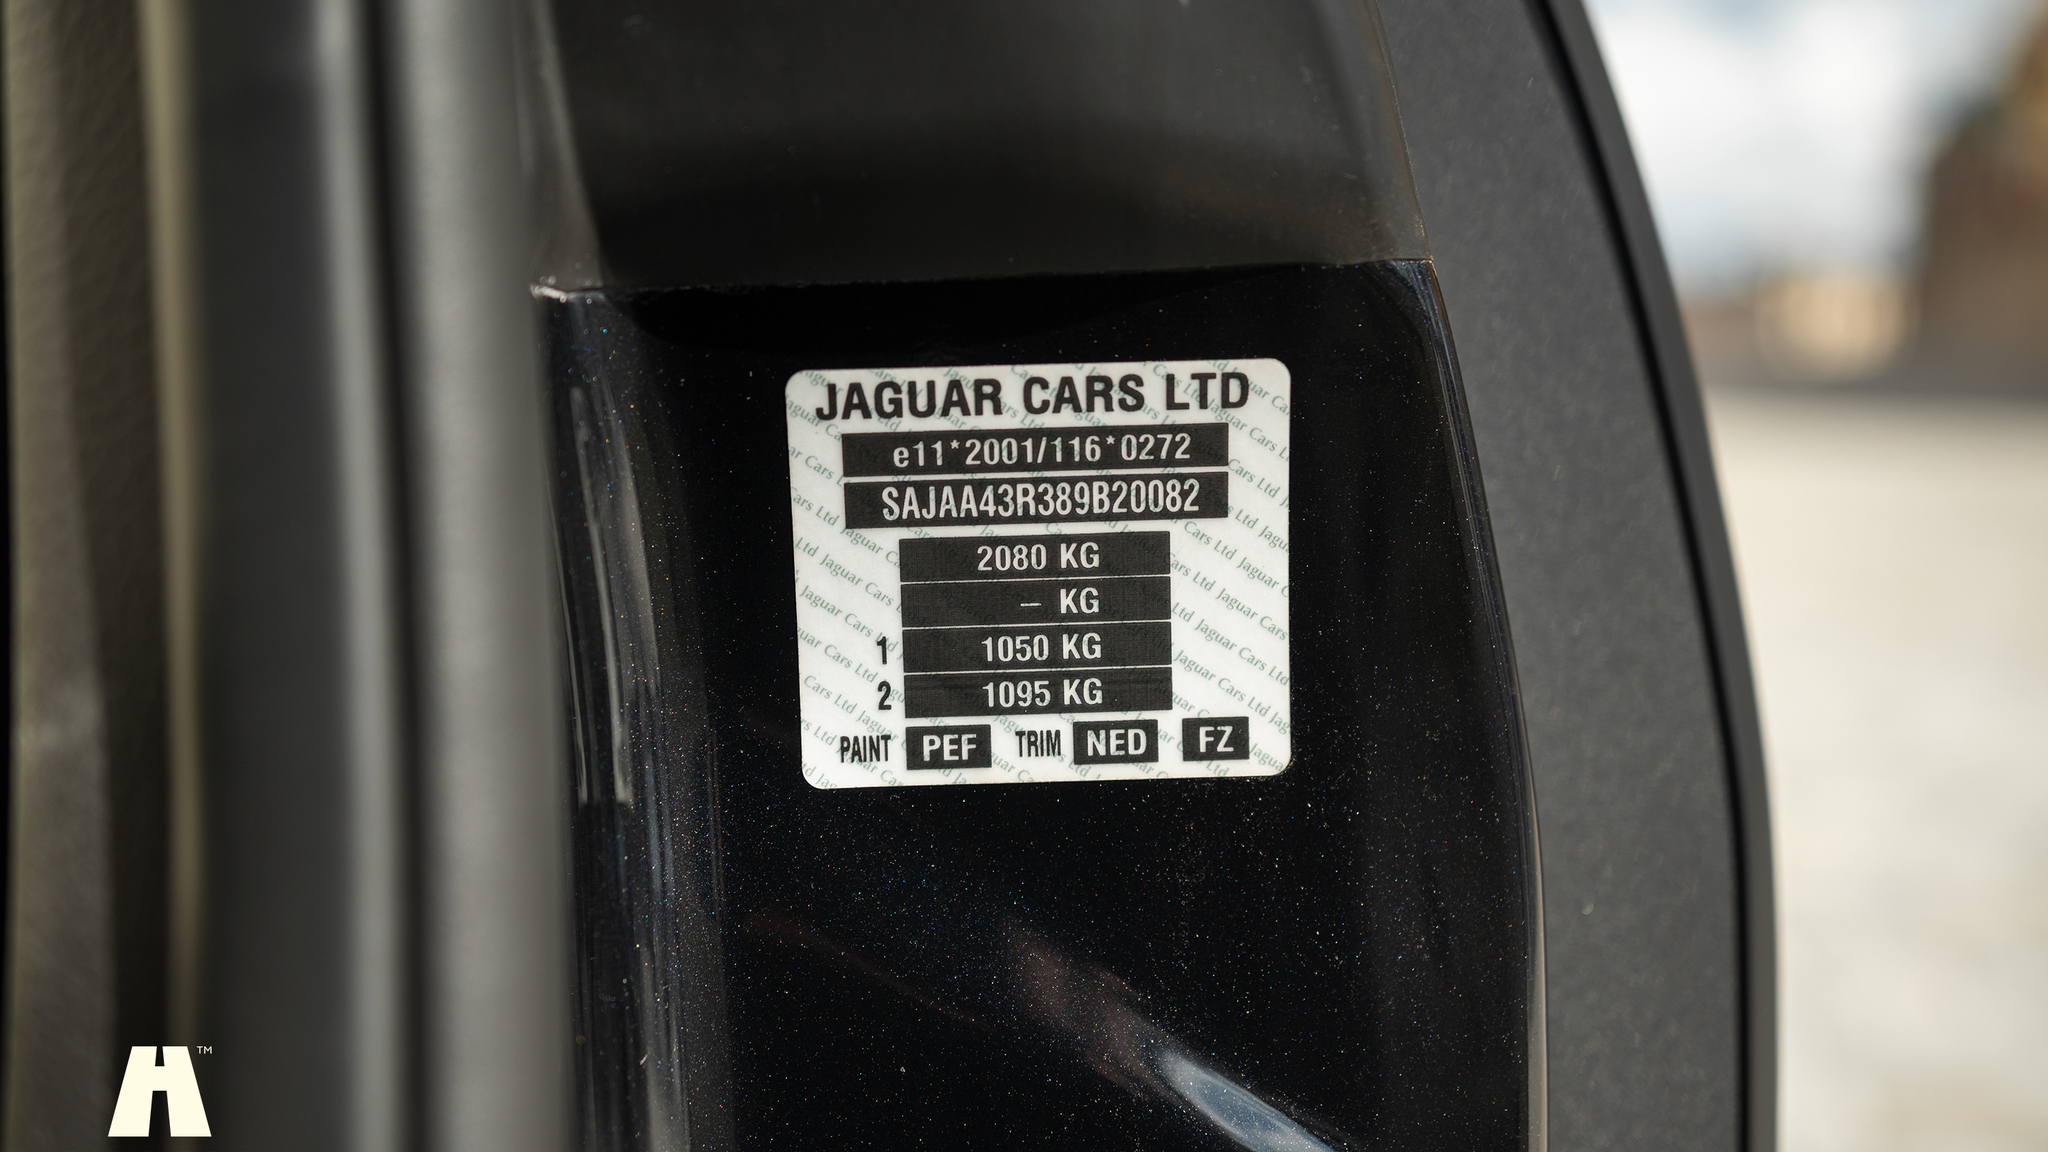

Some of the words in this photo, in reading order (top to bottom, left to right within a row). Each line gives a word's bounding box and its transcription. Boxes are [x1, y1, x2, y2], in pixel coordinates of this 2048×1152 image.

[868, 369, 897, 382] ars
[815, 377, 1003, 421] JAGUAR
[1023, 373, 1146, 415] CARS
[1166, 371, 1249, 411] LTD
[1000, 396, 1019, 419] ars
[1153, 364, 1183, 388] Cas
[1249, 427, 1278, 452] Cars
[1271, 396, 1291, 416] Ca
[785, 395, 822, 427] aguar
[825, 423, 842, 442] Ca
[805, 455, 835, 480] Cars
[1227, 458, 1256, 483] Cars
[1256, 477, 1281, 498] Ltd
[881, 478, 1201, 521] SAJAA43R389B20082
[815, 506, 840, 526] Ltd
[885, 550, 901, 568] Ca
[1234, 509, 1260, 529] Ltd
[1258, 525, 1290, 553] Jagu
[795, 537, 819, 557] Ltd
[819, 554, 863, 586] Jaguar
[865, 582, 894, 607] Cars
[976, 545, 1048, 572] 2080
[1060, 542, 1100, 569] KG
[1184, 520, 1213, 545] Cars
[1213, 540, 1238, 560] Ltd
[1236, 557, 1280, 589] Jaguar
[799, 585, 843, 617] Jaguar
[844, 613, 873, 638] Cars
[875, 632, 899, 652] Ld
[1060, 587, 1100, 614] KG
[1192, 571, 1217, 591] Ltd
[1215, 588, 1259, 620] Jaguar
[1260, 615, 1289, 641] Cars
[824, 644, 854, 669] Cars
[854, 663, 879, 683] Ltd
[876, 636, 888, 665] 1
[981, 635, 1050, 662] 1050
[1062, 632, 1102, 660] KG
[1171, 602, 1195, 623] Ltd
[1193, 618, 1238, 651] Jaguar
[1239, 647, 1268, 671] Cars
[1268, 666, 1291, 686] Ltd
[803, 675, 833, 700] Cars
[834, 694, 858, 714] Ltd
[877, 680, 892, 710] 2
[982, 680, 1051, 708] 1095
[1063, 677, 1103, 705] KG
[1173, 649, 1217, 682] Jaguar
[1218, 677, 1247, 702] Cars
[1247, 697, 1272, 717] Ltd
[1268, 712, 1291, 735] Jag
[813, 726, 838, 746] Ltd
[840, 734, 892, 764] PAINT
[922, 733, 977, 762] PEF
[1014, 729, 1062, 758] TRIM
[1087, 728, 1147, 757] NED
[1199, 725, 1235, 753] FZ
[802, 762, 817, 777] td
[1249, 743, 1285, 773] Jagua
